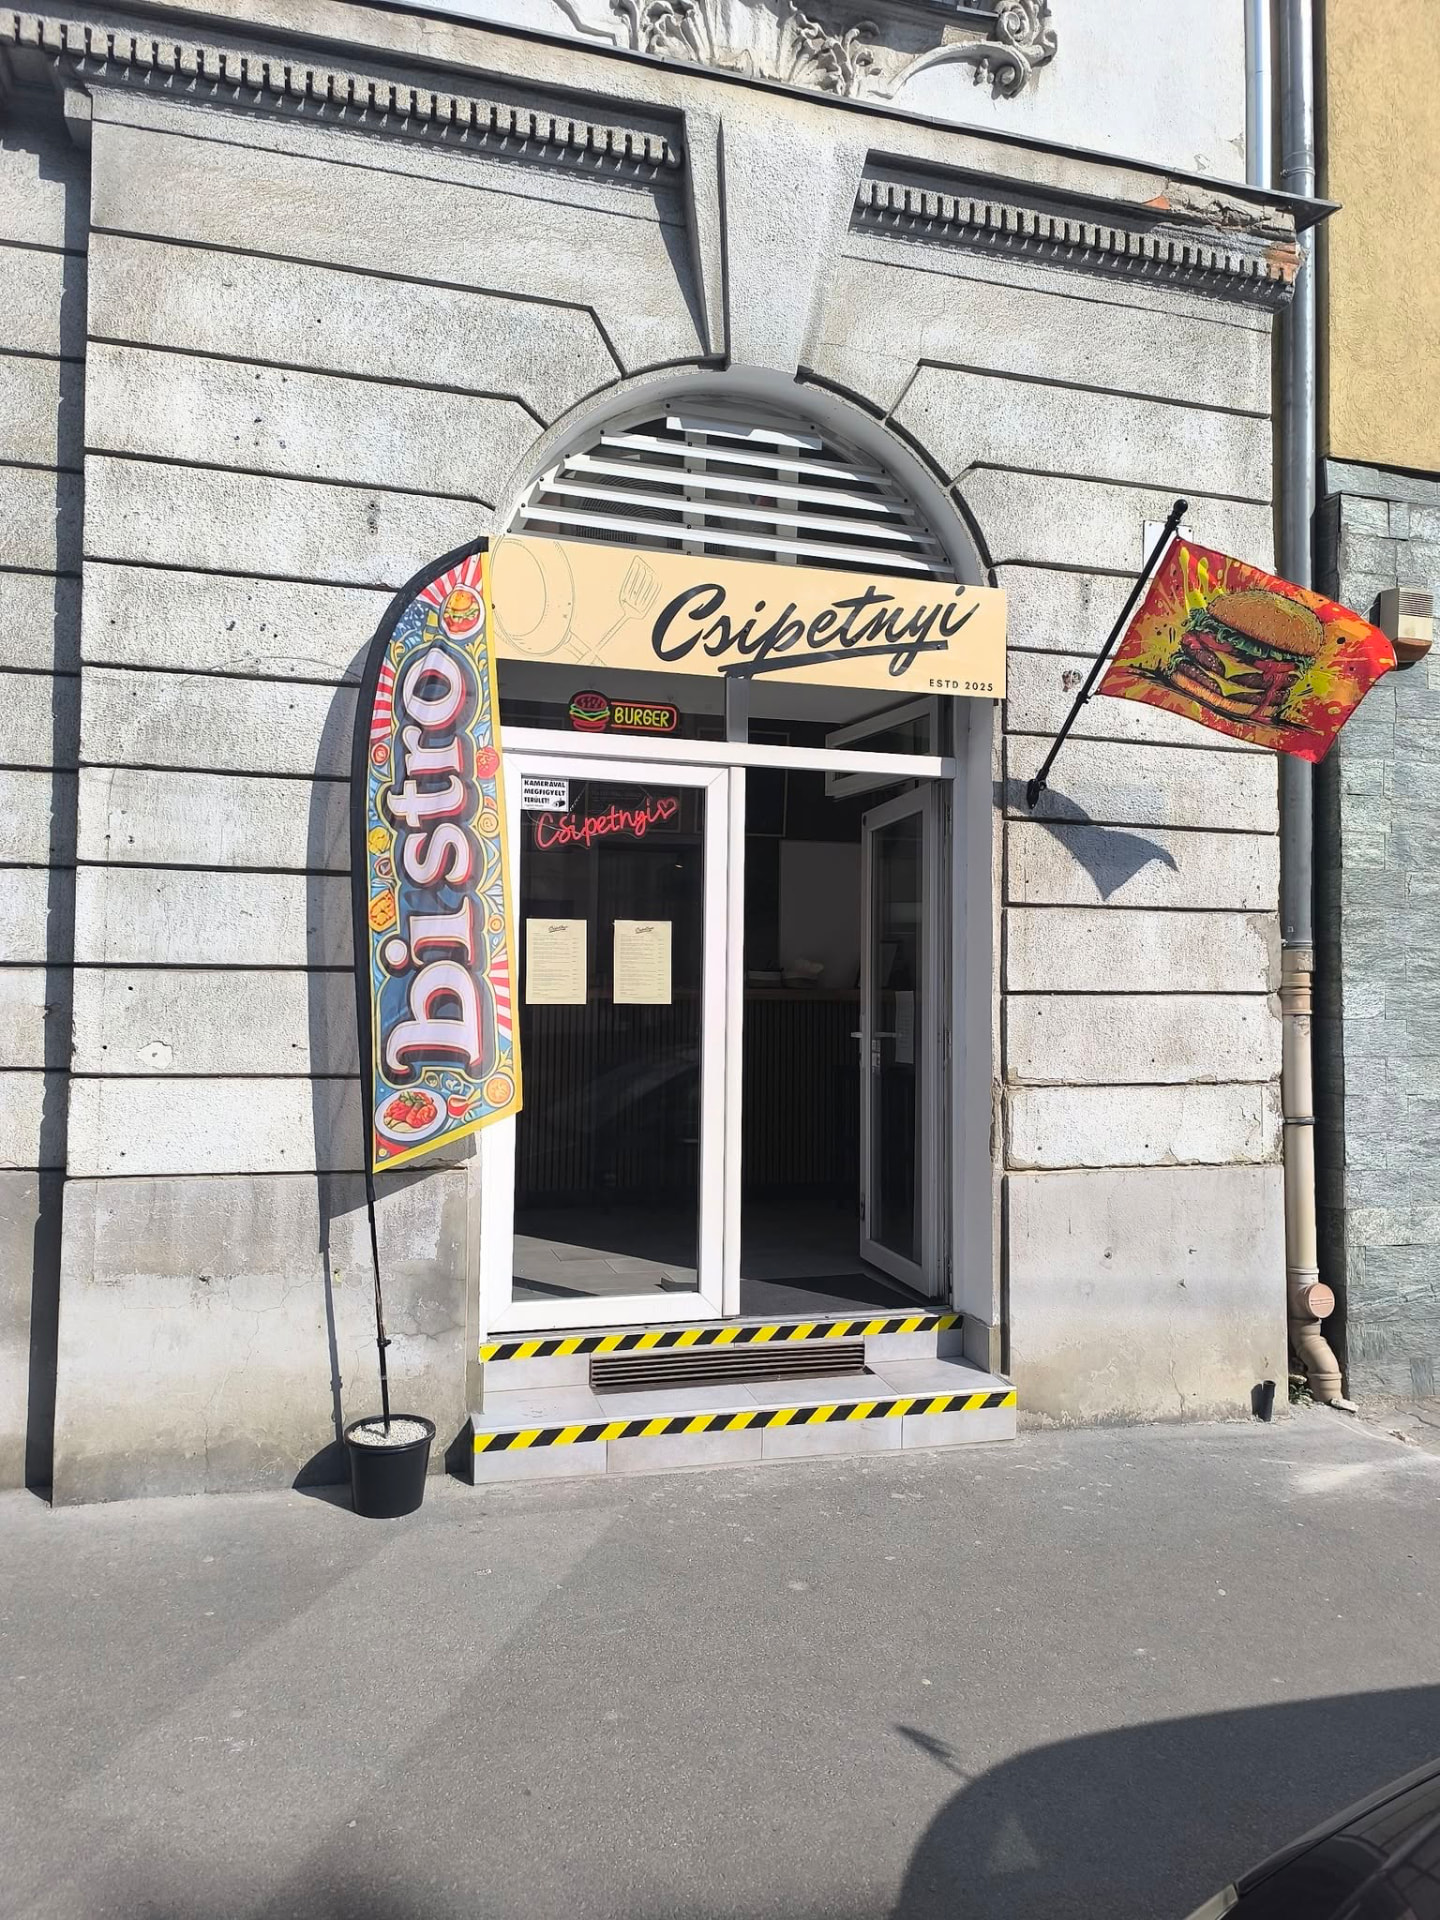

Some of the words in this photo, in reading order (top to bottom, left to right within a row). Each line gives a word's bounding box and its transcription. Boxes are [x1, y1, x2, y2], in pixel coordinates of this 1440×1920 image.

[651, 585, 981, 678] Csipetnyi
[929, 679, 959, 689] ESTD
[965, 681, 993, 692] 2025
[614, 706, 670, 727] BURGER
[524, 788, 566, 796] MEGFIGYELT
[537, 795, 663, 848] Csipetnyi
[383, 647, 481, 1072] bistro
